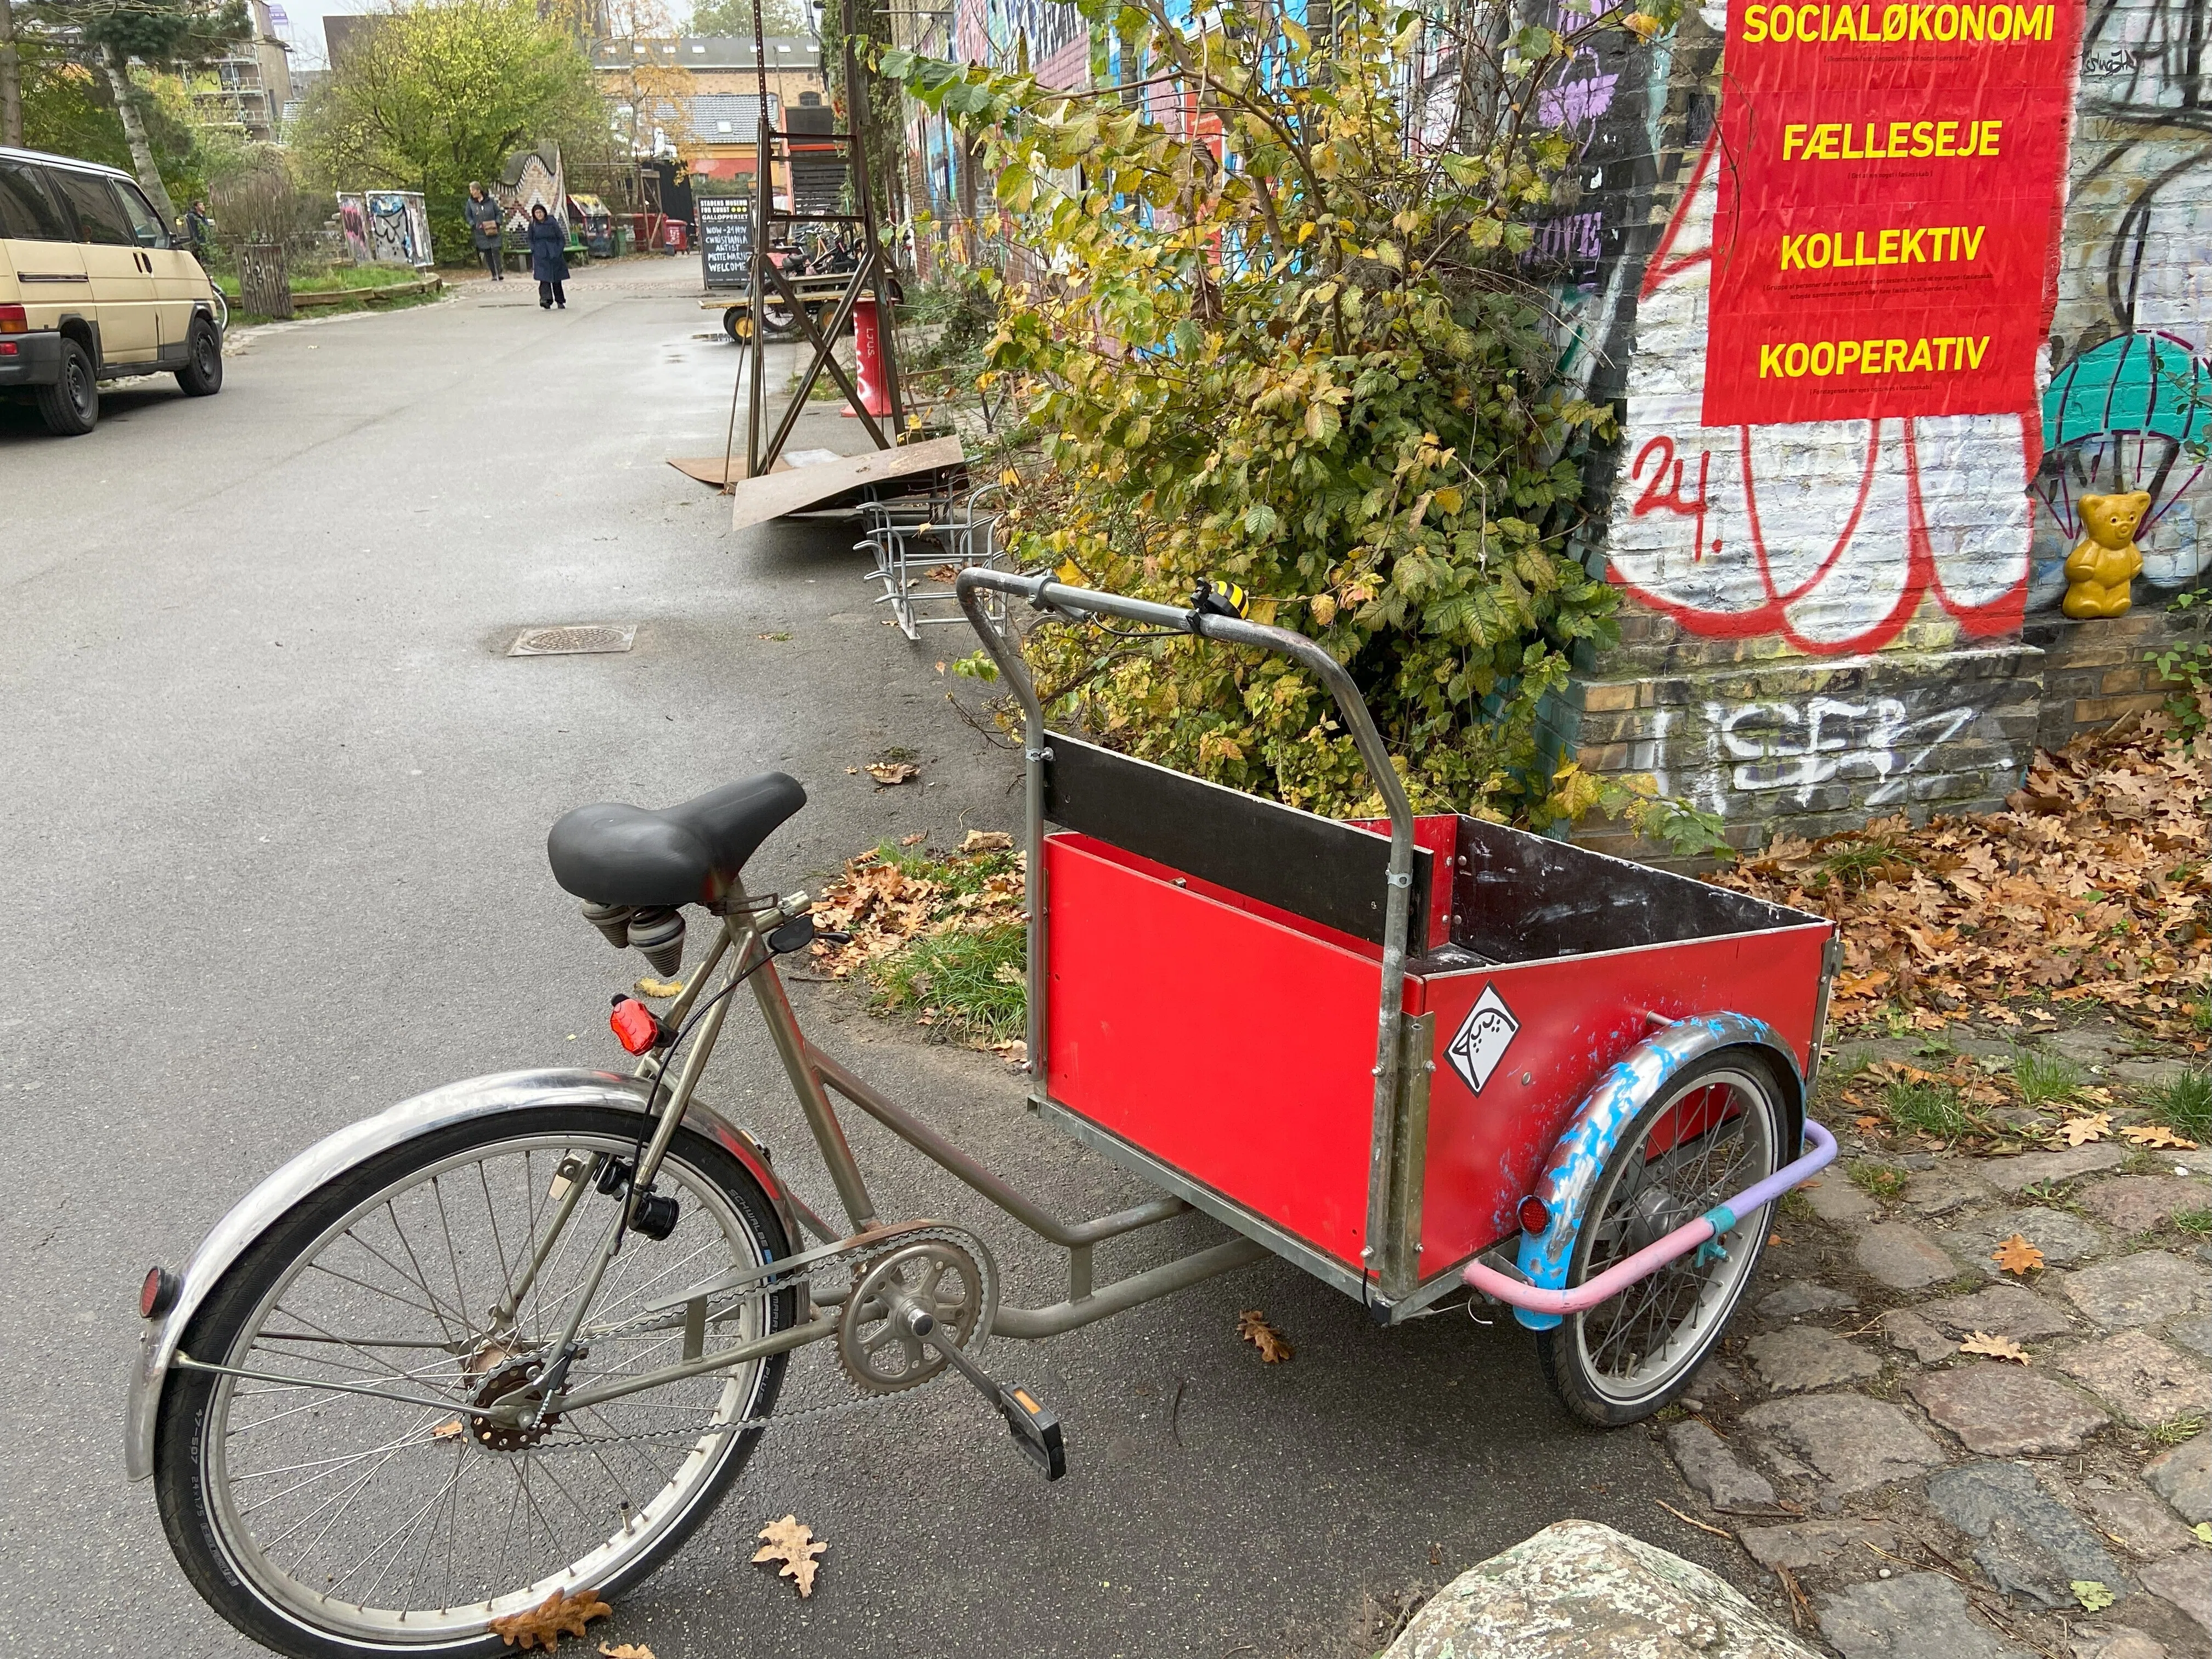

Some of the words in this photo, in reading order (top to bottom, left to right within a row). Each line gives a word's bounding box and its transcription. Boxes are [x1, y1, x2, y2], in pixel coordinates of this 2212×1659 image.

[1742, 3, 2055, 43] SOCIALØKONOMI
[1782, 120, 2003, 161] FÆLLESEJE
[708, 262, 747, 272] WELCOME
[1781, 225, 1985, 270] KOLLEKTIV
[1759, 336, 1990, 379] KOOPERATIV
[727, 1189, 768, 1247] SCHWALBE
[191, 1408, 203, 1465] 47-507
